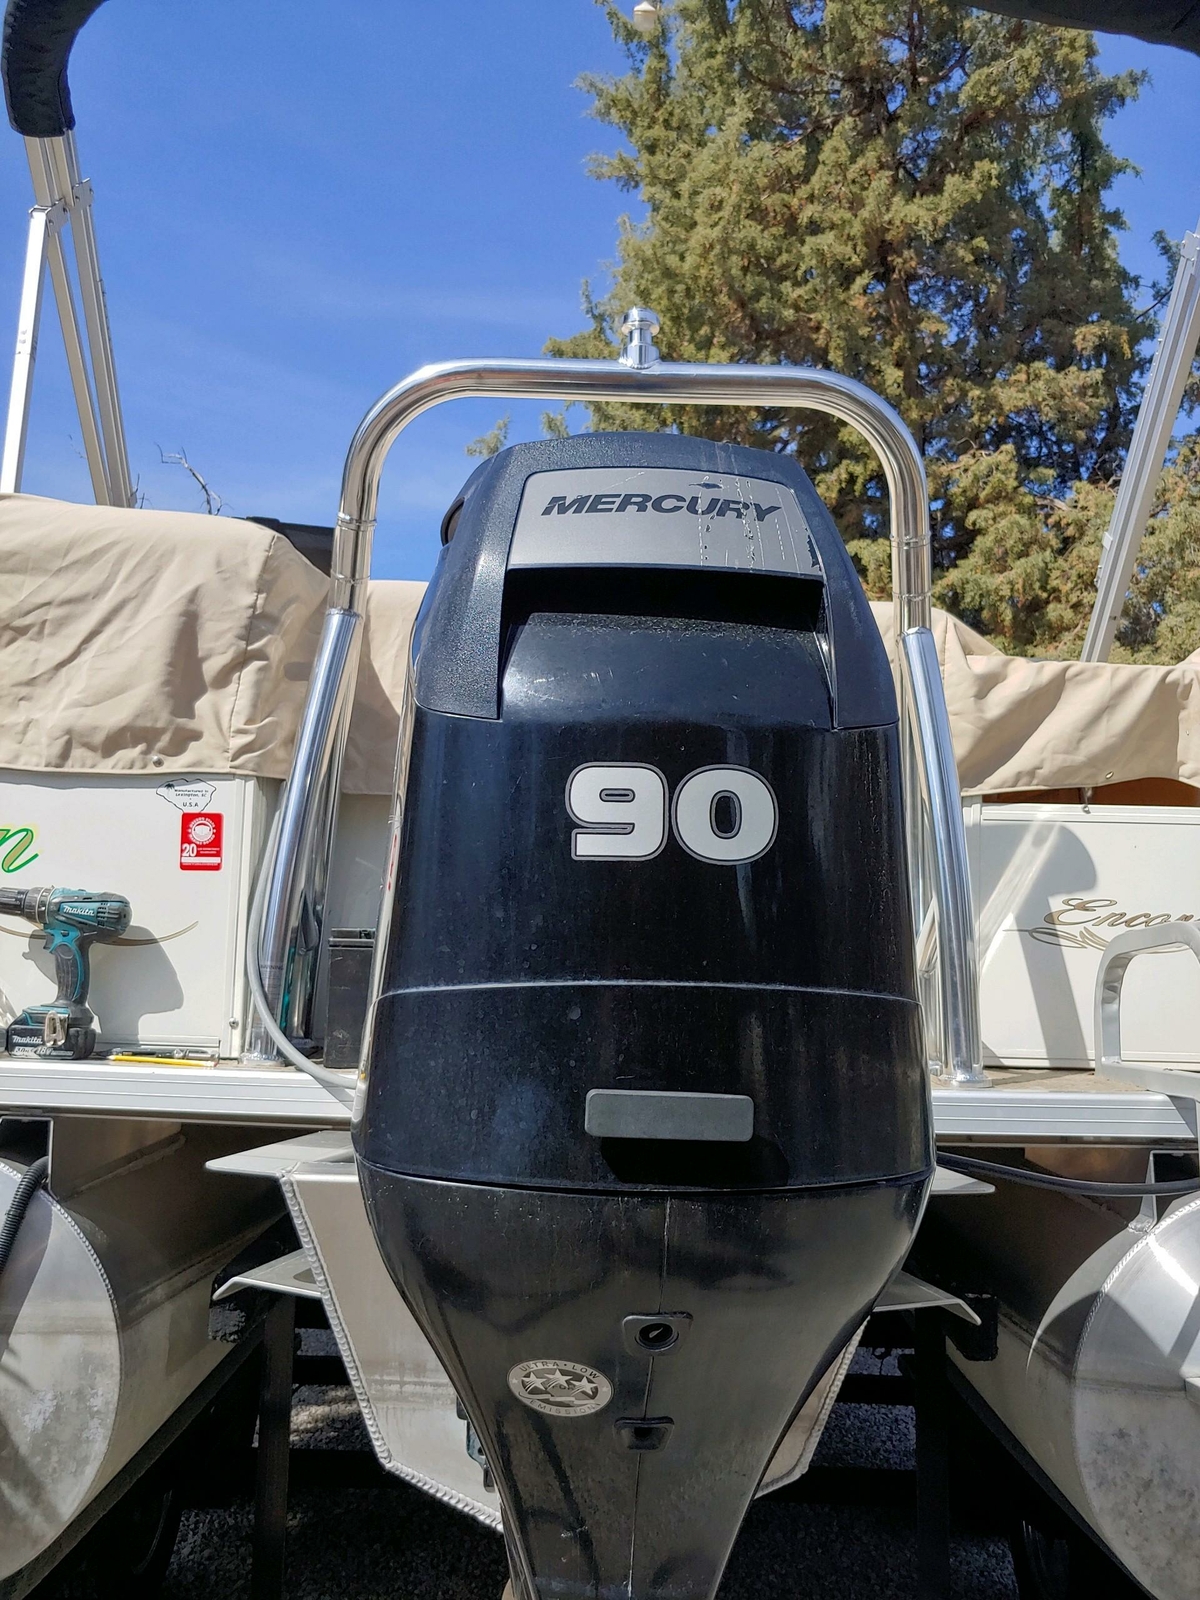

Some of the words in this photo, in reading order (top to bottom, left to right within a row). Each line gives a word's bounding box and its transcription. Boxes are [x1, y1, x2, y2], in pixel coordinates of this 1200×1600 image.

[541, 493, 781, 522] MERCURY
[565, 761, 779, 866] 90
[182, 843, 197, 857] 20
[519, 1361, 560, 1372] ULTRA
[571, 1364, 600, 1379] LOW
[529, 1399, 597, 1415] EMISSION
